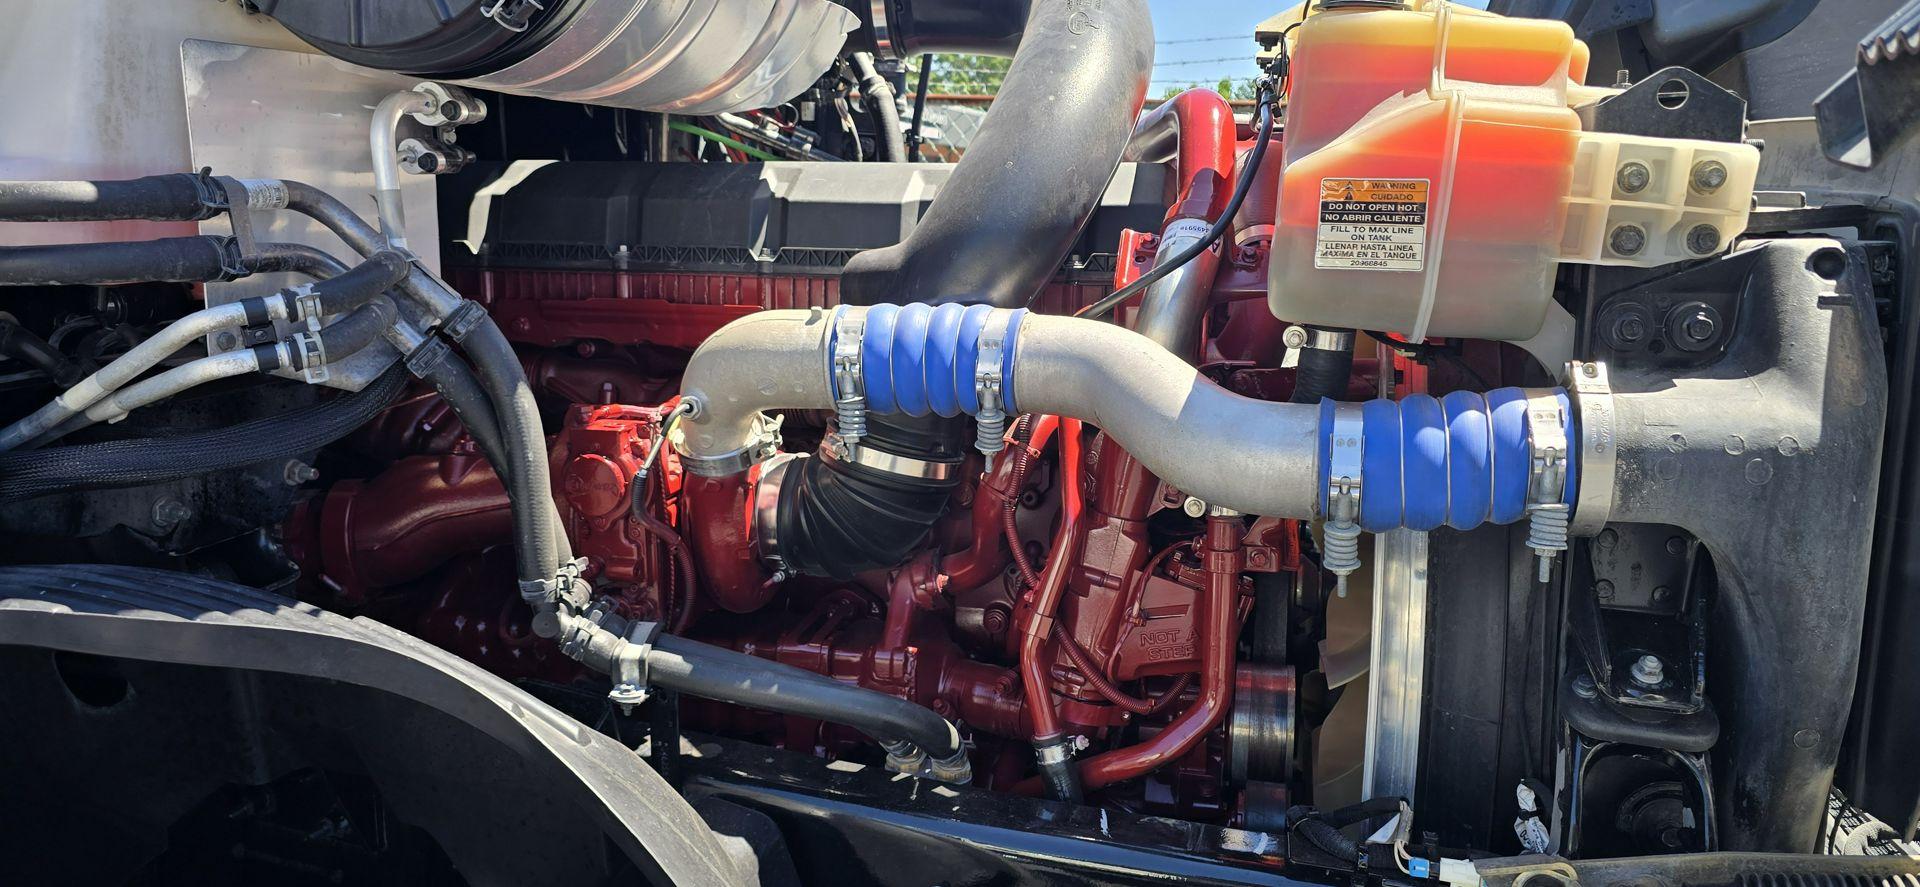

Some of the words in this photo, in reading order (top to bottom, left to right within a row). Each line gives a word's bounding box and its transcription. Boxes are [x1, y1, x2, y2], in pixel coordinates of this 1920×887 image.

[1371, 193, 1414, 201] CUIDADO
[1368, 203, 1395, 211] OPEN
[1397, 204, 1419, 212] HOT
[1325, 213, 1340, 221] NO
[1341, 214, 1372, 222] ABRIR
[1374, 214, 1421, 223] CALIENTE
[1392, 227, 1414, 235] LINE
[1368, 234, 1393, 242] TANK
[1389, 244, 1414, 252] LINEA
[1383, 252, 1417, 260] TANQUE
[1140, 629, 1180, 646] NOT
